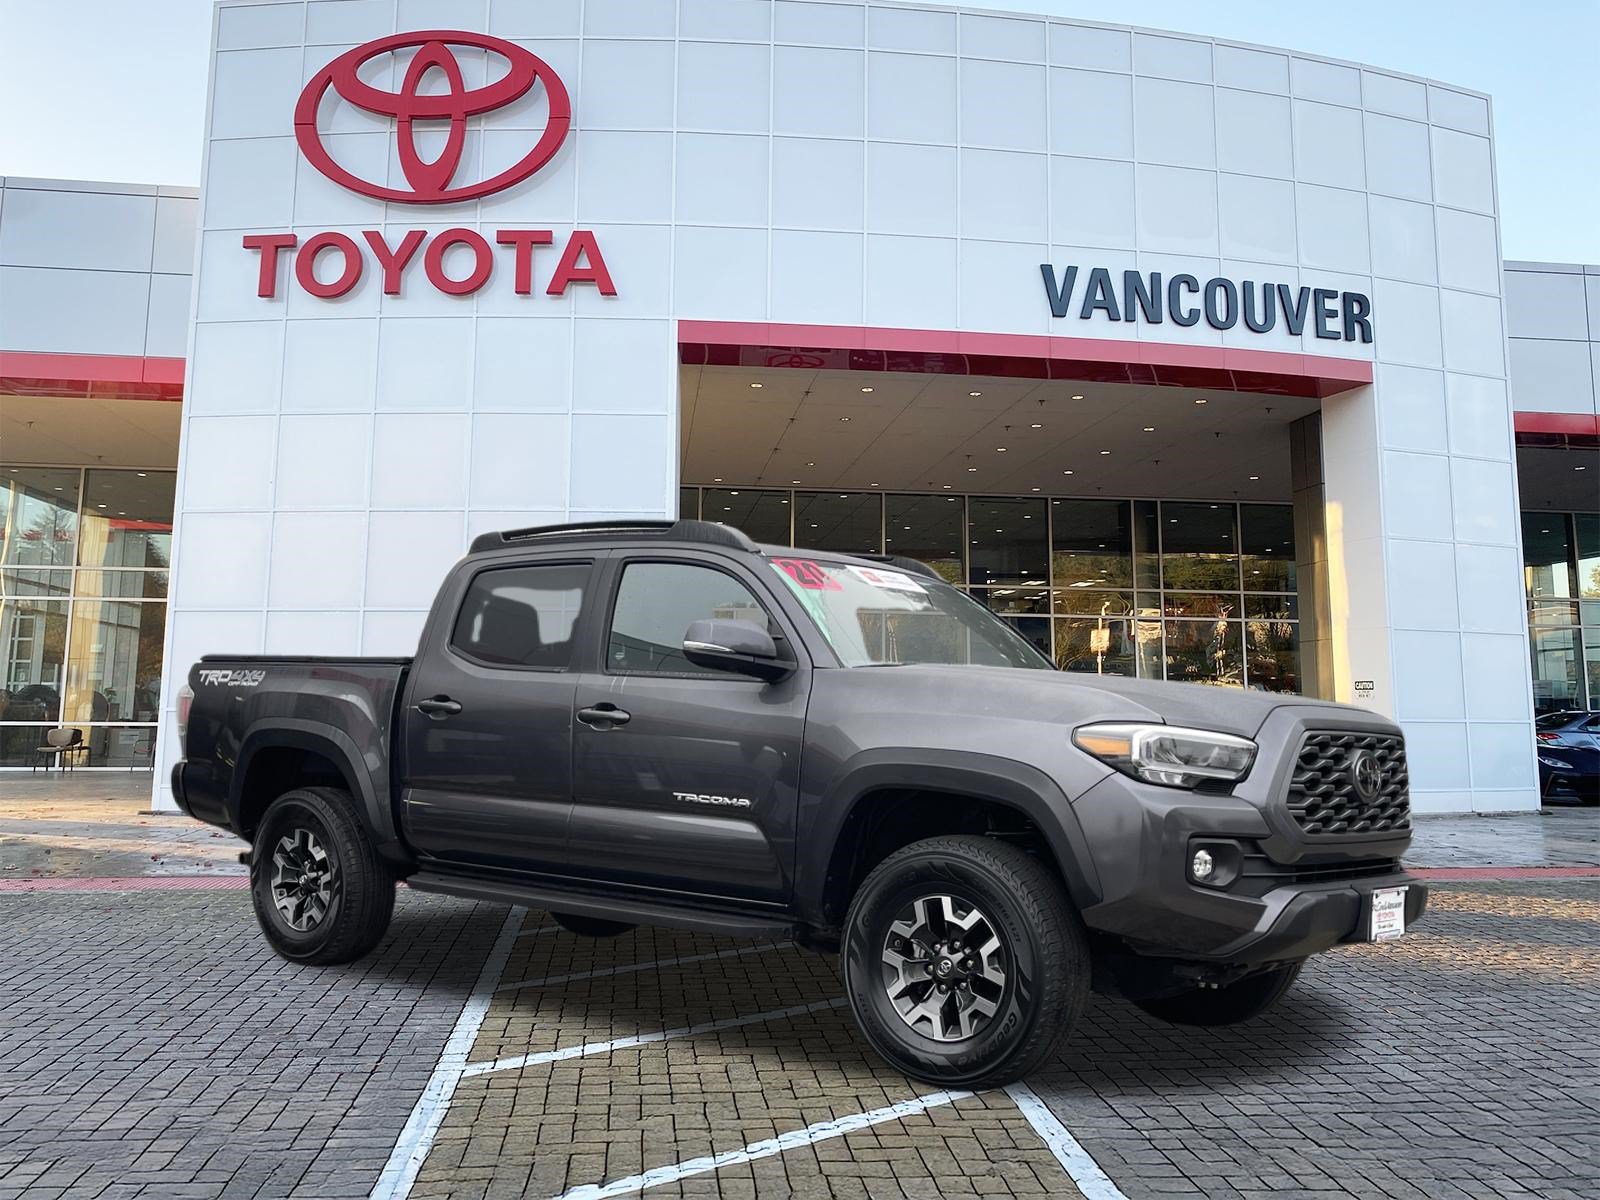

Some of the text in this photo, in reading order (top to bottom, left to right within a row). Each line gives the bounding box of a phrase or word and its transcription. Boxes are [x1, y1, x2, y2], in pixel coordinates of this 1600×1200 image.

[242, 227, 618, 299] TOYOTA
[1040, 264, 1373, 343] VANCOUVER
[199, 669, 232, 686] TRD
[672, 792, 751, 807] TACOMA
